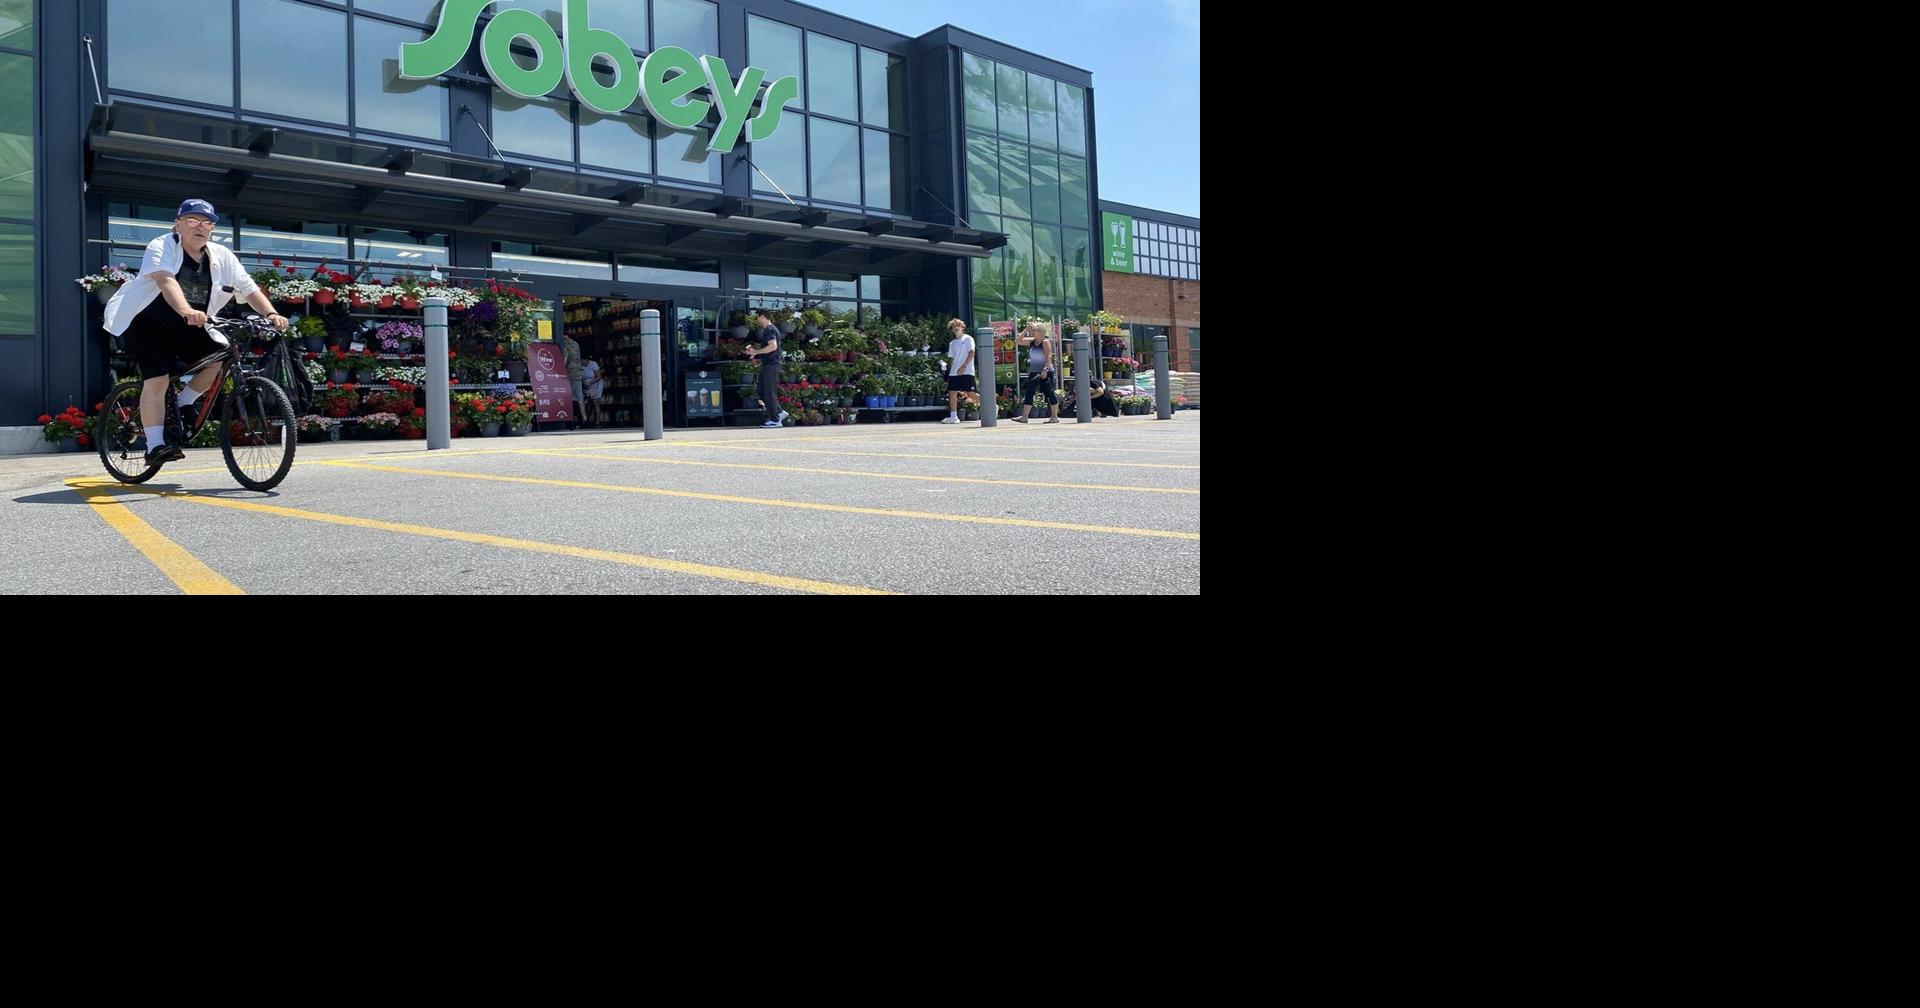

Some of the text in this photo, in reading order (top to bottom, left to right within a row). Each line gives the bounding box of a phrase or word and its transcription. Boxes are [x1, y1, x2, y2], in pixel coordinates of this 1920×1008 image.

[400, 0, 798, 153] Sobeys
[1111, 250, 1125, 258] wine
[1115, 258, 1128, 266] beer
